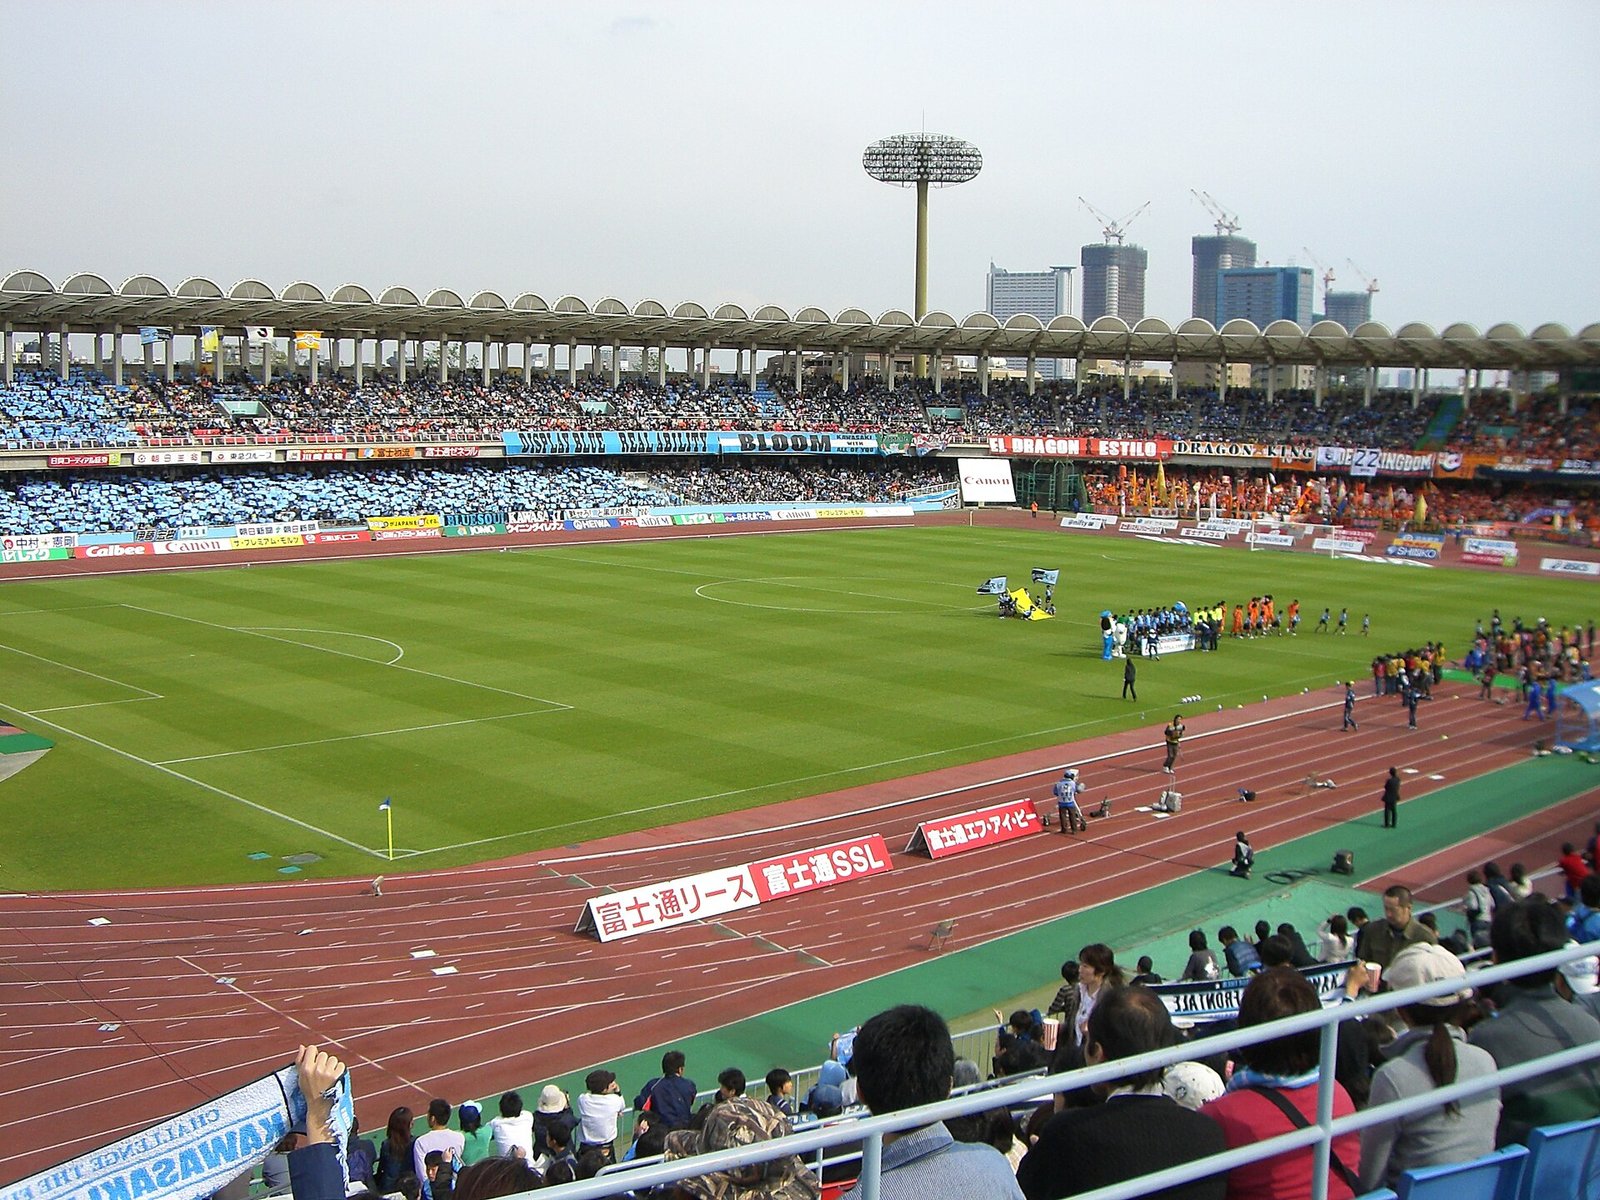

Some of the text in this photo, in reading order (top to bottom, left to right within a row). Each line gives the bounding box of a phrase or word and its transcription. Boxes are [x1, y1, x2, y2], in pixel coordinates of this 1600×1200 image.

[519, 432, 708, 453] DISPLAY BLUE REAL ABILITY
[738, 433, 832, 452] BLOOM
[989, 437, 1157, 457] EL DRAGON ESTILO
[1175, 440, 1313, 459] DRAGON KING
[1354, 449, 1380, 468] 22
[964, 476, 1010, 485] Canon
[777, 509, 811, 519] Canon
[469, 525, 496, 535] JOMO
[583, 518, 611, 529] HEIWA
[16, 537, 39, 548] 中村
[165, 541, 221, 552] Canon
[233, 537, 299, 547] ザ・プレミアム・モルツ
[18, 548, 50, 560] レイク
[86, 543, 145, 558] Calbee
[762, 844, 885, 896] 富士通SSL
[596, 874, 754, 936] 富士通リース
